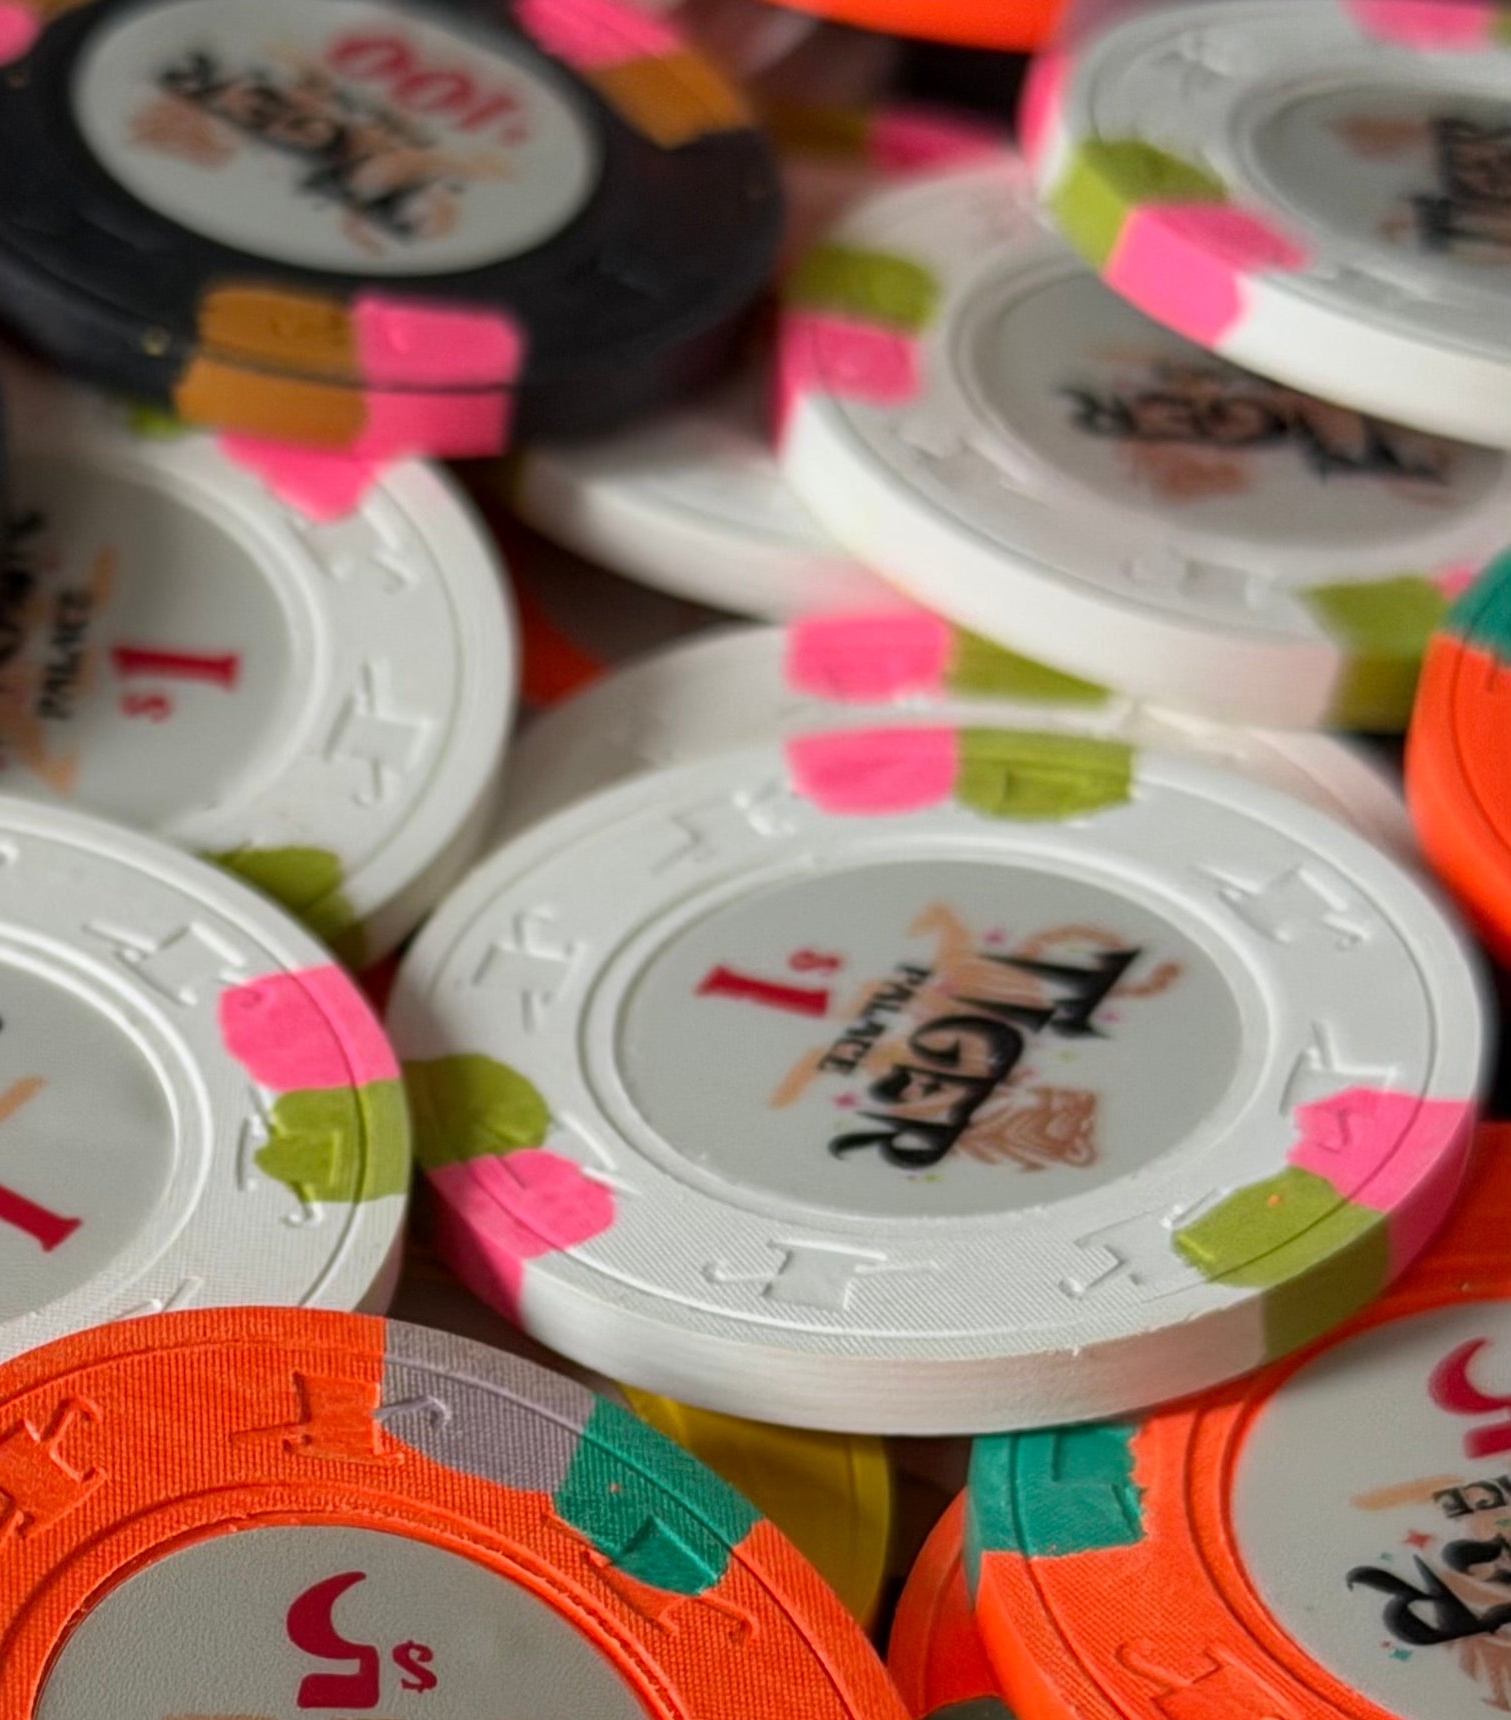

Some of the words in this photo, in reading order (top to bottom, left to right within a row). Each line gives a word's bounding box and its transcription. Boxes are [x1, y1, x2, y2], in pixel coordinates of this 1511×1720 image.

[109, 642, 242, 722] $1
[696, 949, 843, 1017] $1
[818, 965, 929, 1077] PALACE
[827, 947, 1143, 1170] TIGER
[285, 1570, 438, 1711] $5
